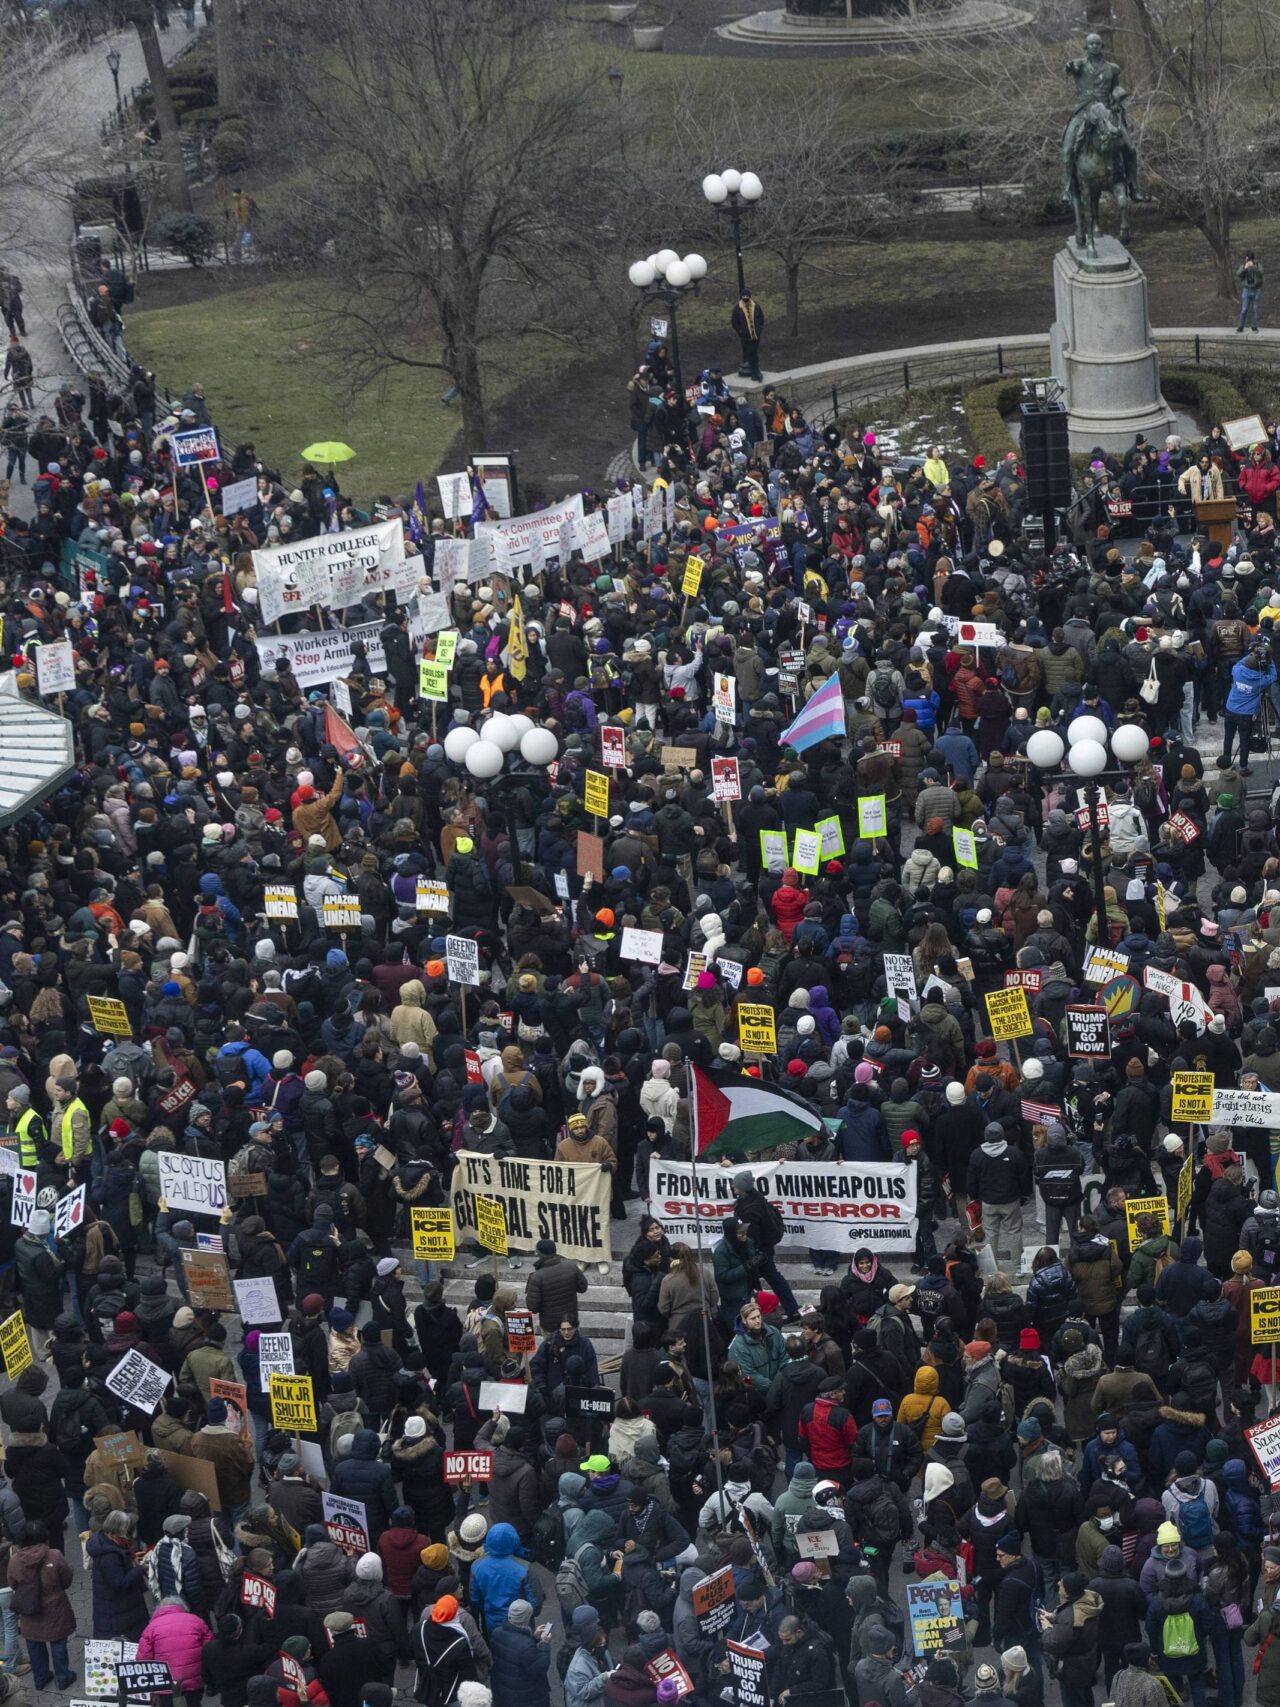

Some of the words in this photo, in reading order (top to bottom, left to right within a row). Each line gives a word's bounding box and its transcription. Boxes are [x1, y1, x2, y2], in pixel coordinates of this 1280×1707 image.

[510, 511, 562, 535] Committee
[565, 508, 576, 522] to
[278, 546, 326, 567] HUNTER
[328, 535, 379, 556] COLLEGE
[294, 633, 338, 653] Workers
[296, 654, 320, 668] Stop
[422, 669, 445, 680] ABOLISH
[427, 678, 439, 690] ICE!
[715, 780, 738, 790] GENERAL
[715, 789, 740, 799] STRIKE
[1079, 810, 1090, 822] NO
[1171, 812, 1186, 827] NO
[1182, 821, 1199, 839] ICE!
[266, 886, 296, 897] AMAZON
[417, 880, 448, 891] AMAZON
[325, 895, 360, 905] AMAZON
[416, 893, 449, 912] UNFAIR
[267, 900, 299, 918] UNFAIR
[325, 909, 362, 926] UNFAIR
[447, 937, 476, 955] DEFEND
[886, 957, 898, 967] NO
[899, 957, 912, 967] ONE
[1093, 948, 1129, 966] AMAZON
[1007, 973, 1020, 986] NO
[1022, 972, 1040, 987] ICE!
[987, 988, 1022, 1000] FIGHT
[90, 999, 109, 1008] DROP
[110, 1001, 124, 1011] THE
[739, 1006, 773, 1017] PROTESTING
[741, 1015, 773, 1028] ICE
[1068, 1012, 1106, 1023] TRUMP
[1072, 1023, 1103, 1034] MUST
[742, 1038, 775, 1047] CRIME!
[1080, 1034, 1097, 1043] GO
[1075, 1041, 1104, 1053] NOW!
[1175, 1074, 1212, 1085] PROTESTING
[160, 1095, 177, 1111] NO
[176, 1080, 193, 1101] ICE!
[1175, 1084, 1211, 1096] ICE
[1216, 1091, 1235, 1100] Dad
[1238, 1092, 1250, 1101] did
[1253, 1094, 1267, 1103] not
[1179, 1099, 1187, 1109] IS
[1187, 1099, 1200, 1109] NOT
[1200, 1099, 1206, 1109] A
[466, 1158, 492, 1185] IT'S
[499, 1161, 531, 1192] TIME
[539, 1165, 564, 1195] FOR
[568, 1167, 577, 1197] A
[657, 1172, 710, 1200] FROM
[775, 1174, 907, 1201] MINNEAPOLIS
[164, 1178, 211, 1204] FAILED
[210, 1182, 226, 1210] US
[14, 1200, 34, 1225] NY
[664, 1200, 735, 1218] STOP
[785, 1202, 901, 1219] TERROR
[1128, 1199, 1165, 1212] PROTESTING
[413, 1209, 451, 1220] PROTESTING
[414, 1219, 451, 1233] ICE
[538, 1201, 603, 1249] STRIKE
[420, 1235, 427, 1246] IS
[427, 1235, 441, 1246] NOT
[442, 1236, 448, 1247] A
[849, 1227, 912, 1241] @PSLNATIONAL
[415, 1246, 453, 1254] CRIME!
[1258, 1318, 1267, 1329] IS
[1267, 1317, 1280, 1328] NOT
[3, 1335, 18, 1351] CHARGES
[17, 1329, 25, 1339] ON
[261, 1336, 291, 1352] DEFEND
[109, 1352, 142, 1391] DEFEND
[119, 1360, 149, 1399] DEMOCRACY:
[148, 1384, 164, 1407] STRIKE!
[272, 1384, 292, 1401] MLK
[295, 1387, 311, 1403] JR
[275, 1403, 302, 1418] SHUT
[302, 1404, 312, 1419] IT
[580, 1399, 611, 1413] ICE=DEATH
[276, 1415, 313, 1425] DOWN!
[446, 1455, 465, 1474] NO
[467, 1455, 490, 1474] ICE!
[328, 1497, 360, 1510] IMMIGRANTS
[328, 1525, 344, 1542] NO
[345, 1530, 366, 1549] ICE!
[807, 1535, 821, 1544] ICE
[706, 1576, 722, 1591] ICE
[245, 1578, 262, 1596] NO
[263, 1587, 276, 1609] ICE!
[700, 1579, 729, 1604] MUST
[702, 1620, 721, 1633] Regime
[721, 1608, 734, 1621] Must
[914, 1616, 958, 1631] SEXIST
[916, 1630, 940, 1641] MAN
[917, 1639, 944, 1650] ALIVE
[282, 1656, 298, 1676] NO
[729, 1651, 764, 1672] TRUMP
[118, 1663, 168, 1677] ABOLISH
[732, 1665, 762, 1683] MUST
[126, 1674, 171, 1689] I.C.E.
[740, 1679, 756, 1693] GO
[738, 1688, 765, 1705] NOW!
